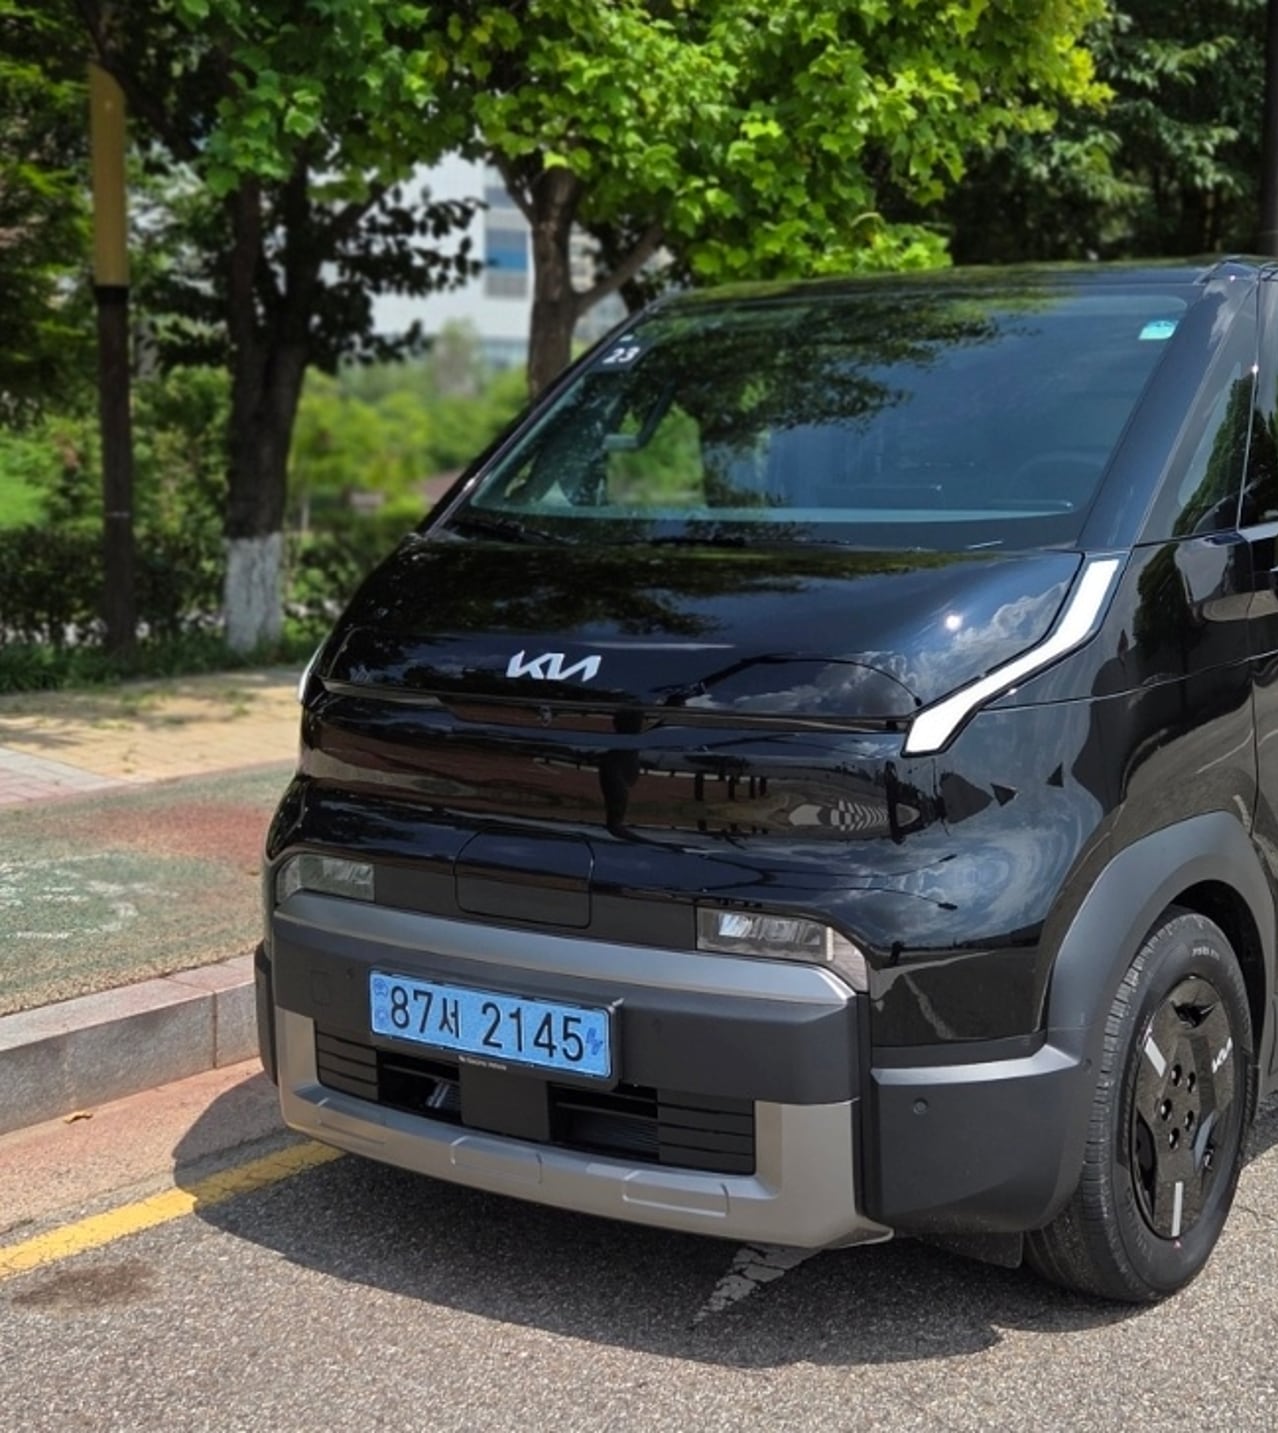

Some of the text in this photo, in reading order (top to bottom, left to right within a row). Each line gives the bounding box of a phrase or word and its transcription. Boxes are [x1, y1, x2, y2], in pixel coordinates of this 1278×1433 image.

[602, 346, 640, 364] 23
[390, 985, 586, 1062] 87서 2145
